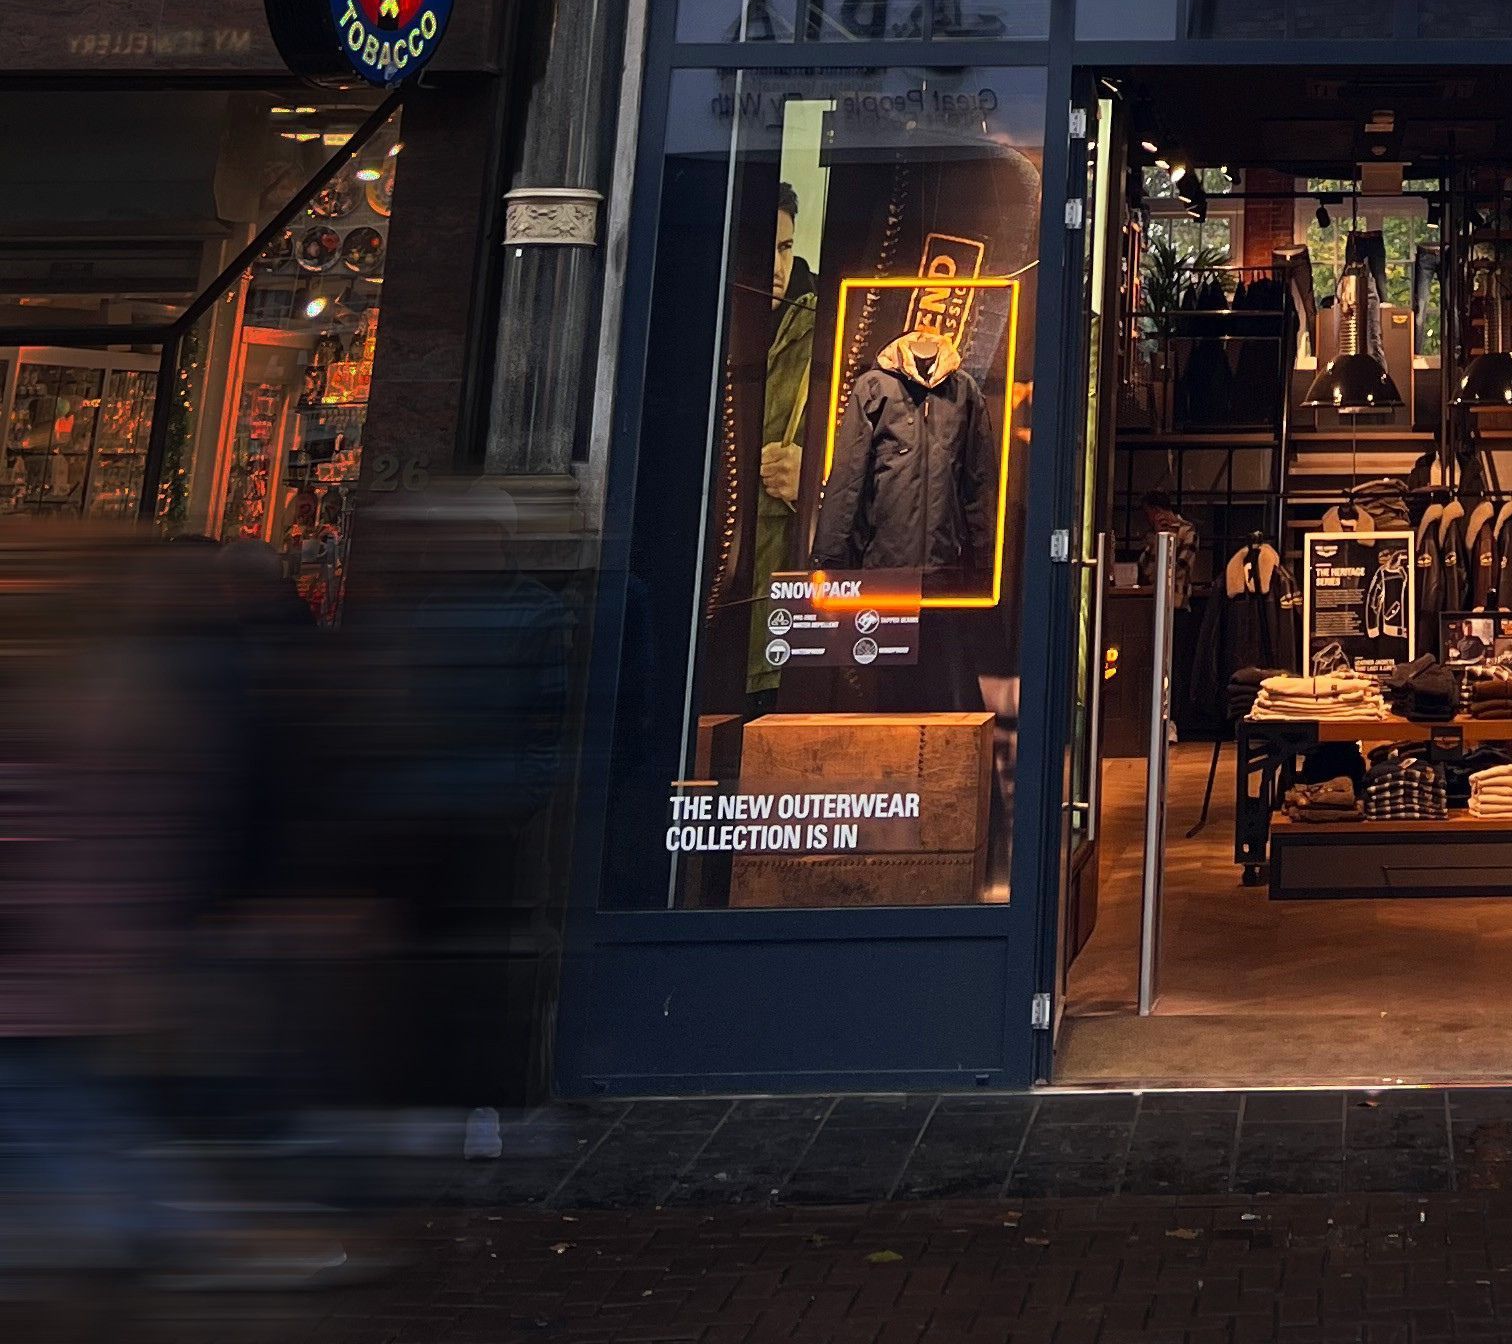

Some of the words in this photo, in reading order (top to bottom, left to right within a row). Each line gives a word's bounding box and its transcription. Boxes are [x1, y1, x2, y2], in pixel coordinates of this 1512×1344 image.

[339, 0, 437, 70] TOBACCO
[368, 454, 431, 492] 26
[670, 796, 712, 820] THE
[717, 795, 774, 820] NEW
[778, 793, 920, 819] OUTERWEAR
[666, 824, 800, 851] COLLECTION
[806, 824, 827, 849] IS
[833, 824, 858, 849] IN
